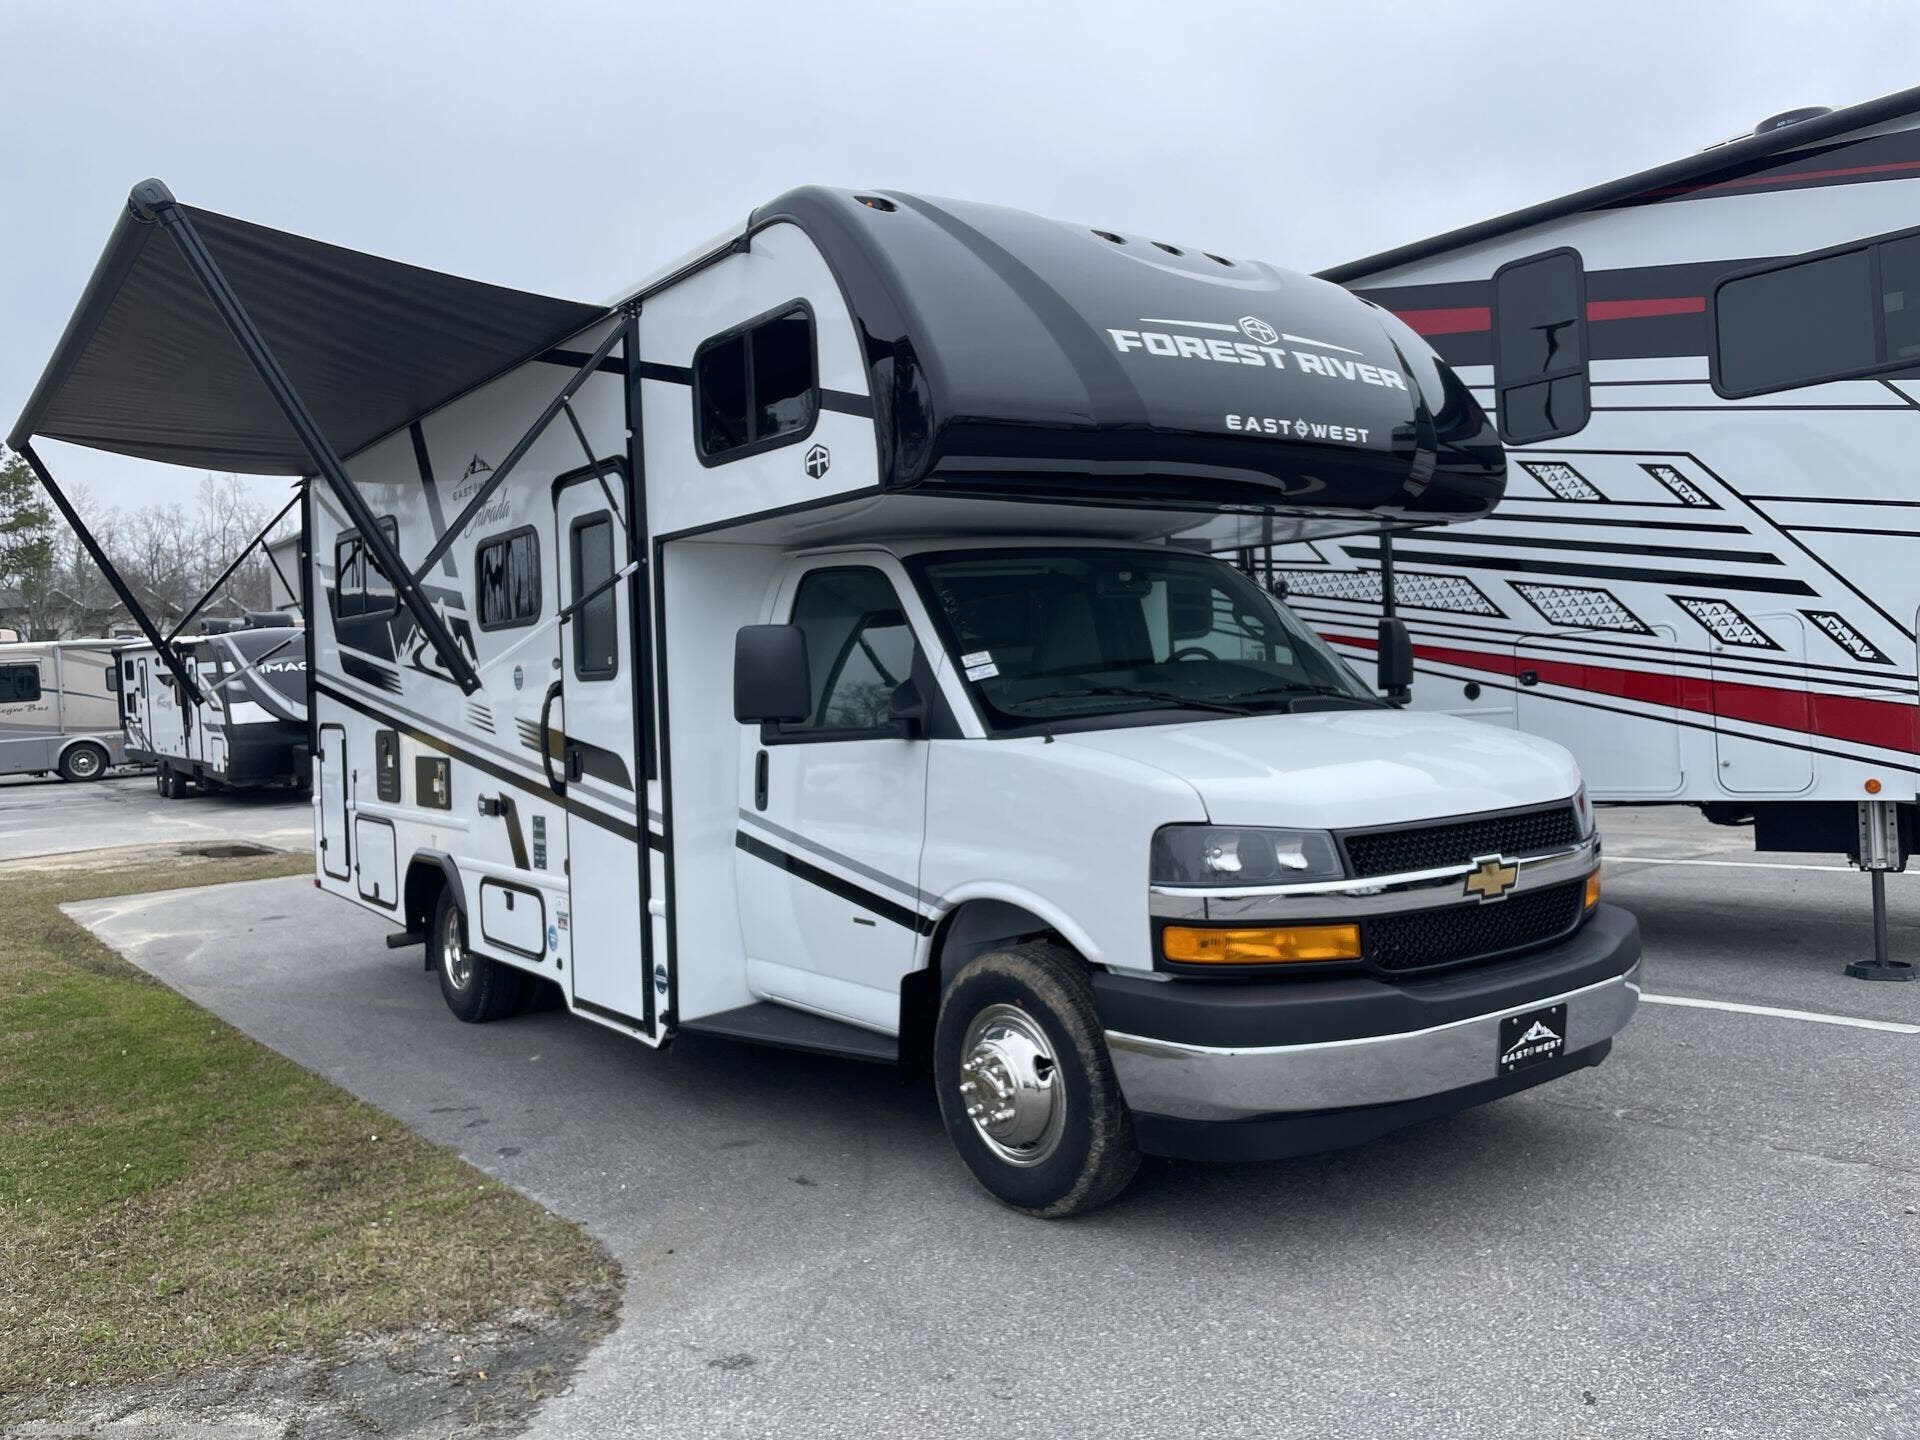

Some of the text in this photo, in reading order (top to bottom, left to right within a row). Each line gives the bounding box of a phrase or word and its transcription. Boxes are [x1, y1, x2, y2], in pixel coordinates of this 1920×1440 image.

[1106, 328, 1408, 391] FOREST RIVER
[1225, 414, 1370, 444] EAST WEST
[1501, 1048, 1529, 1064] EAST
